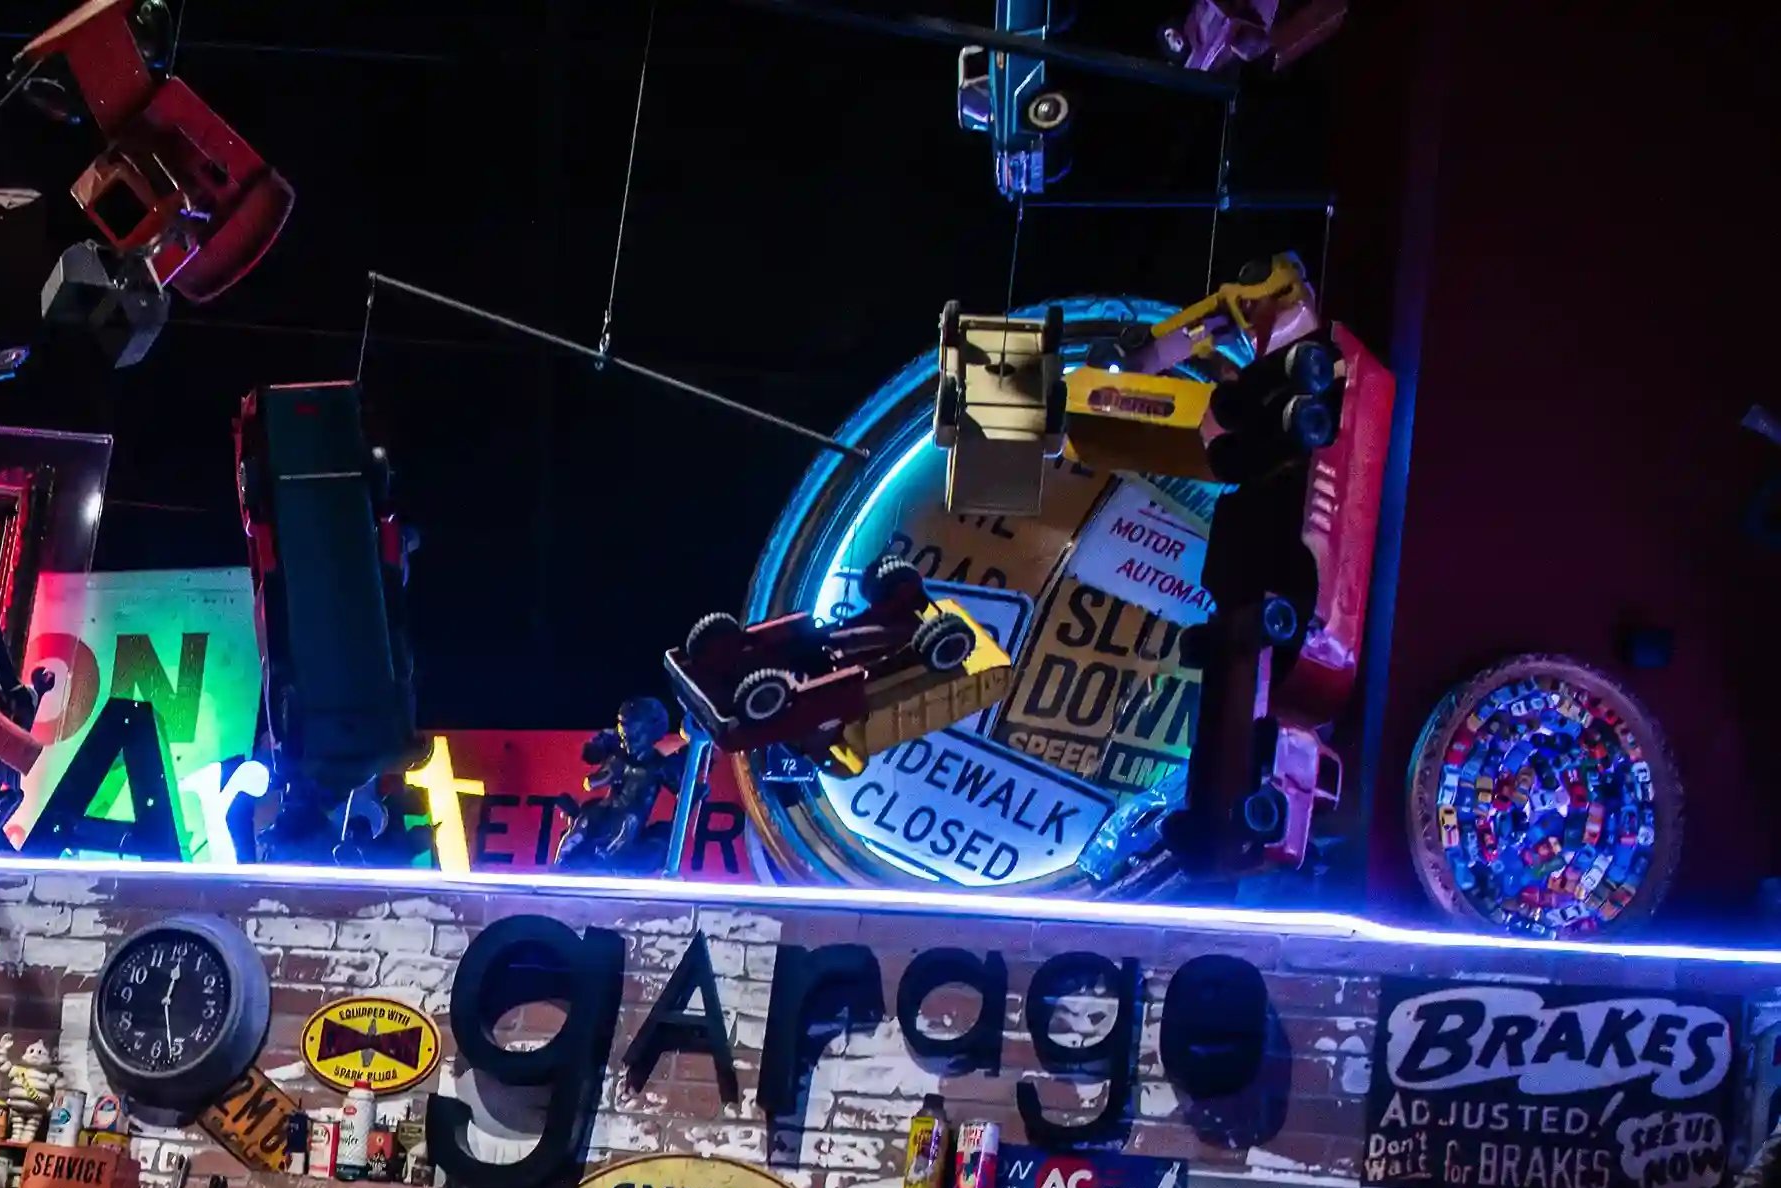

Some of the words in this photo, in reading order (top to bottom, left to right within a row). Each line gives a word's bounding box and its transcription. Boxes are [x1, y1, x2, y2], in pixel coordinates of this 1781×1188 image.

[1111, 517, 1186, 561] MOTOR
[1056, 585, 1178, 661] SLO
[1023, 654, 1203, 746] DOWN
[882, 739, 1081, 845] IDEWALK
[850, 781, 1020, 881] CLOSED
[129, 965, 148, 984] 10
[150, 949, 164, 968] 11
[195, 955, 203, 972] 1
[120, 986, 133, 1004] 9
[119, 1011, 133, 1031] 8
[339, 1007, 385, 1022] EQUIPPED
[387, 1008, 411, 1027] WITH
[150, 1040, 162, 1059] 6
[171, 1037, 185, 1056] 5
[1396, 999, 1725, 1085] BRAKES
[333, 1065, 364, 1081] SPARK
[1367, 1130, 1429, 1160] Don't
[1630, 1118, 1682, 1157] SEE
[1683, 1116, 1718, 1144] US
[32, 1151, 108, 1185] SERVICE
[1364, 1156, 1431, 1183] Wait
[1443, 1138, 1472, 1185] for
[1642, 1148, 1724, 1188] NOW
